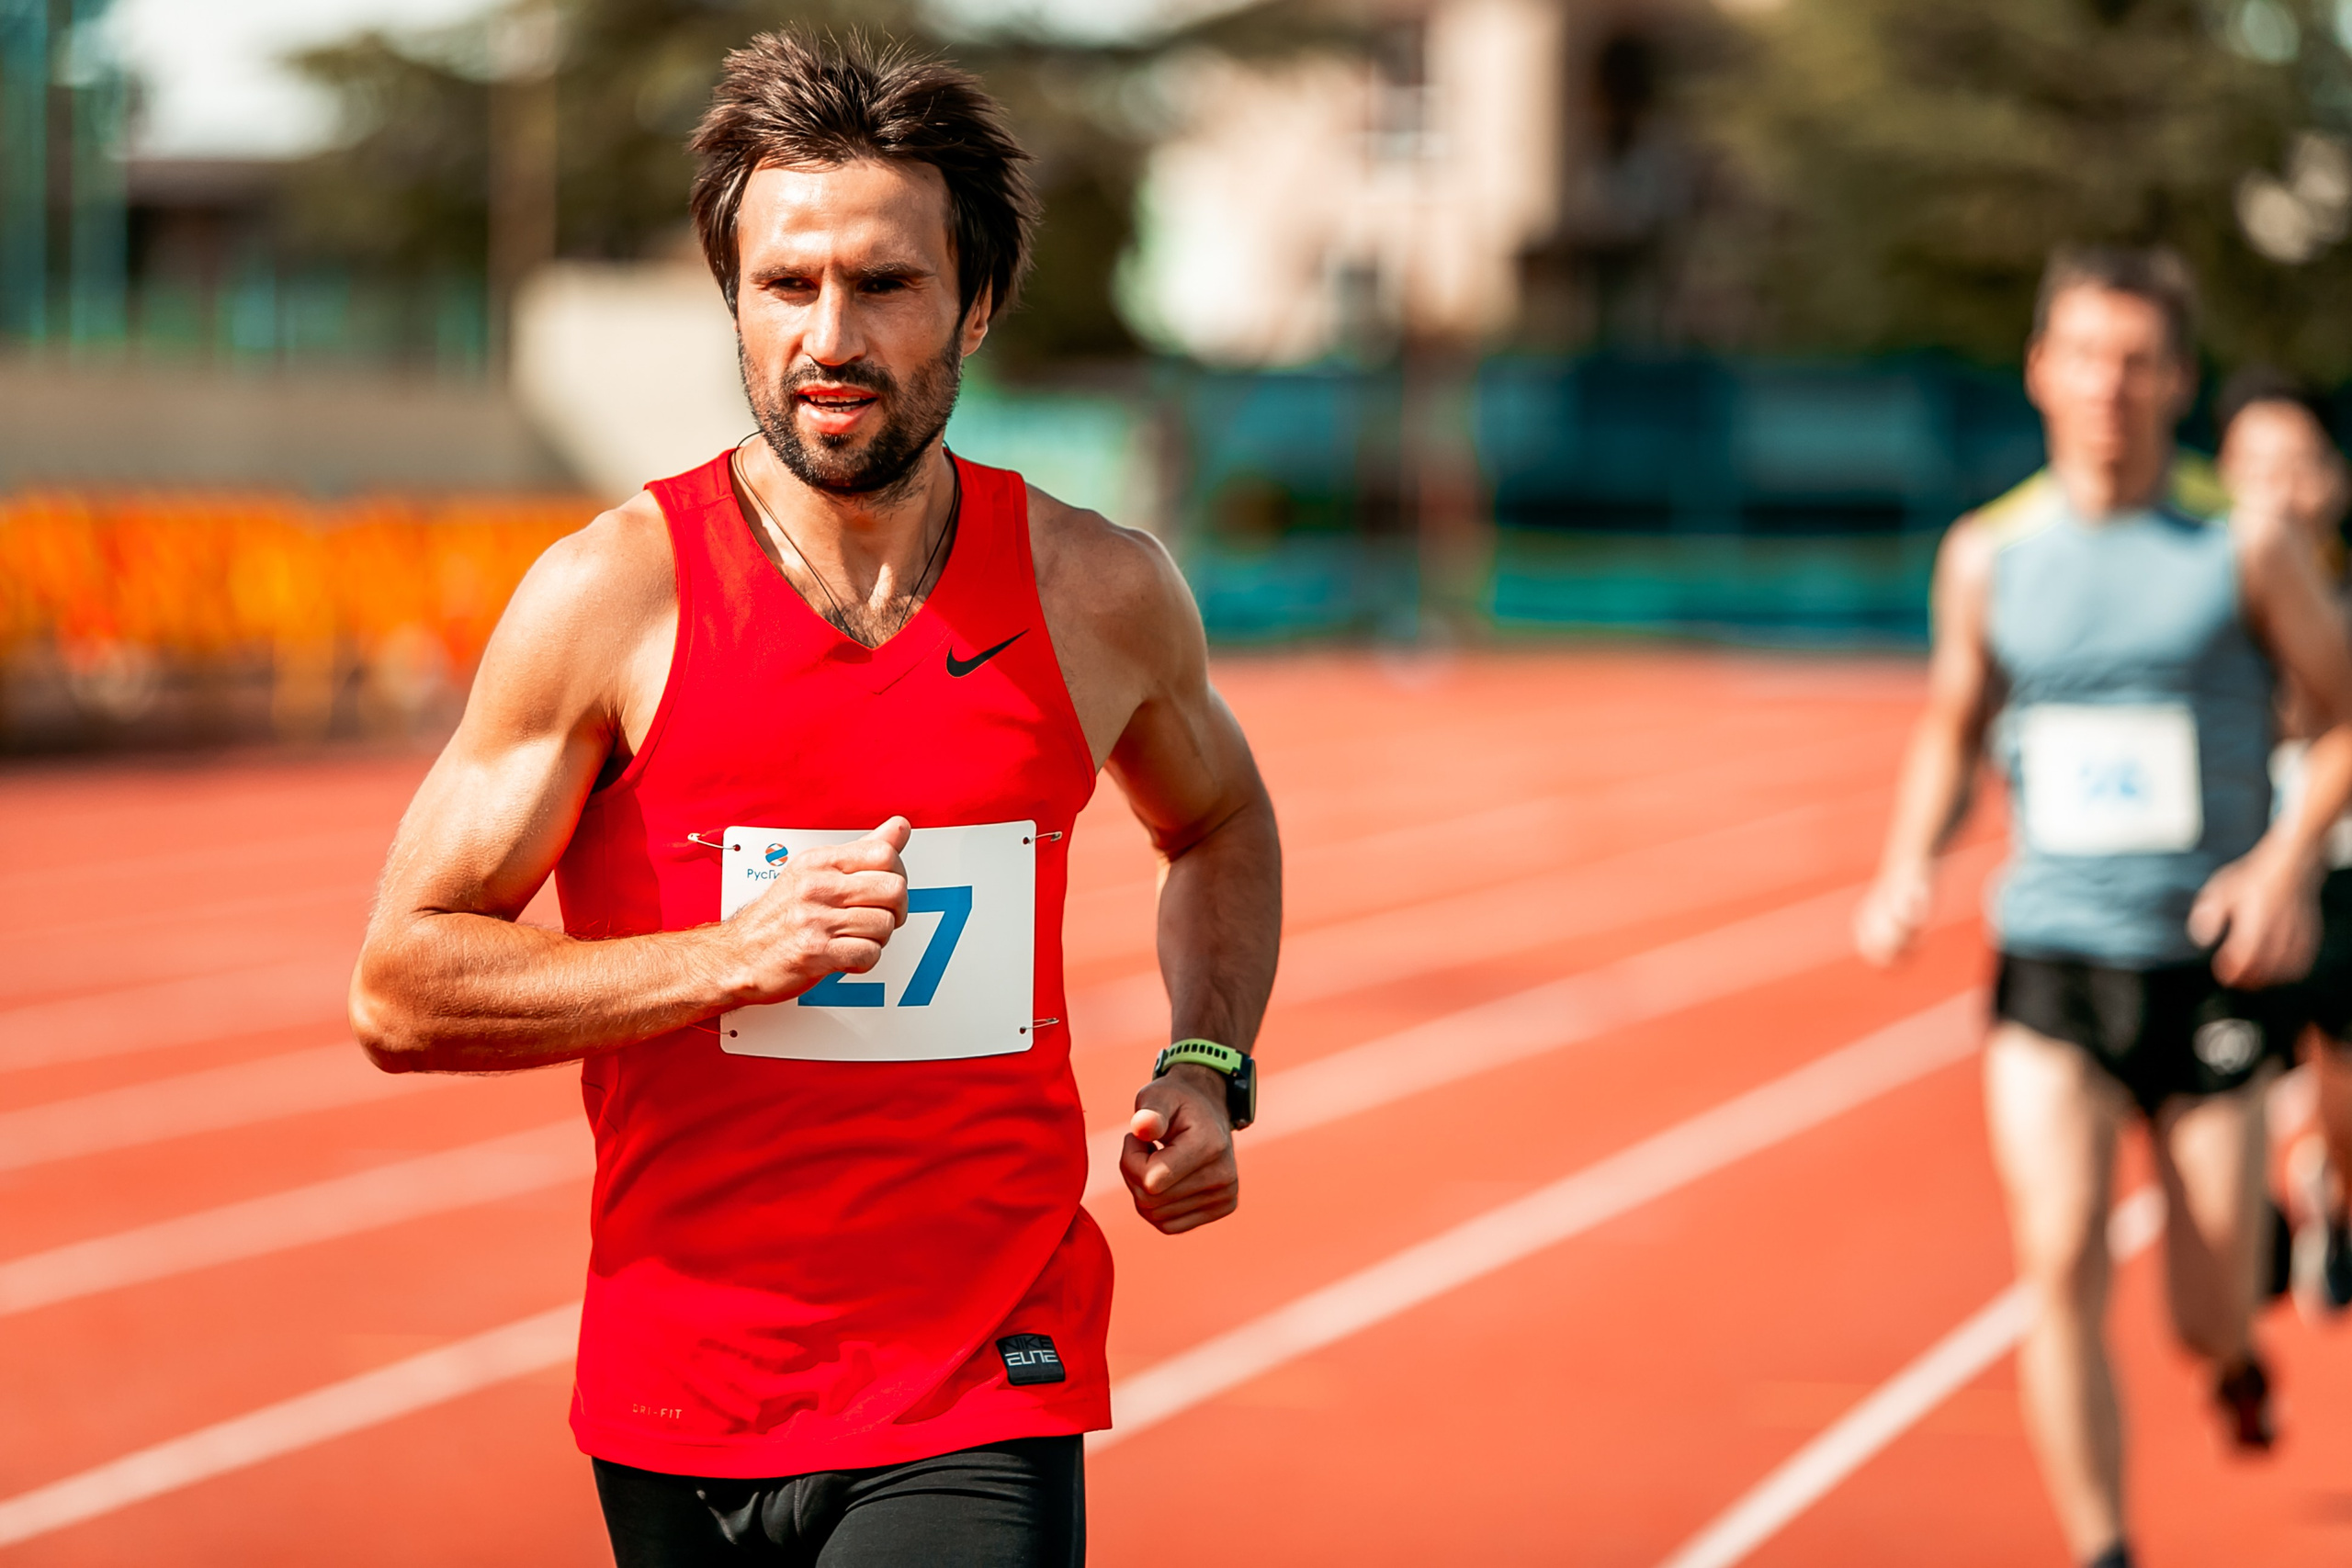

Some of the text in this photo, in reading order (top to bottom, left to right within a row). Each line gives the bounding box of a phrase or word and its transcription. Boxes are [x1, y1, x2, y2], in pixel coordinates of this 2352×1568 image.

[747, 868, 781, 881] РусГи
[1001, 1336, 1054, 1353] NIKE
[1005, 1350, 1058, 1366] ELITE
[632, 1403, 683, 1419] DRI-FIT
